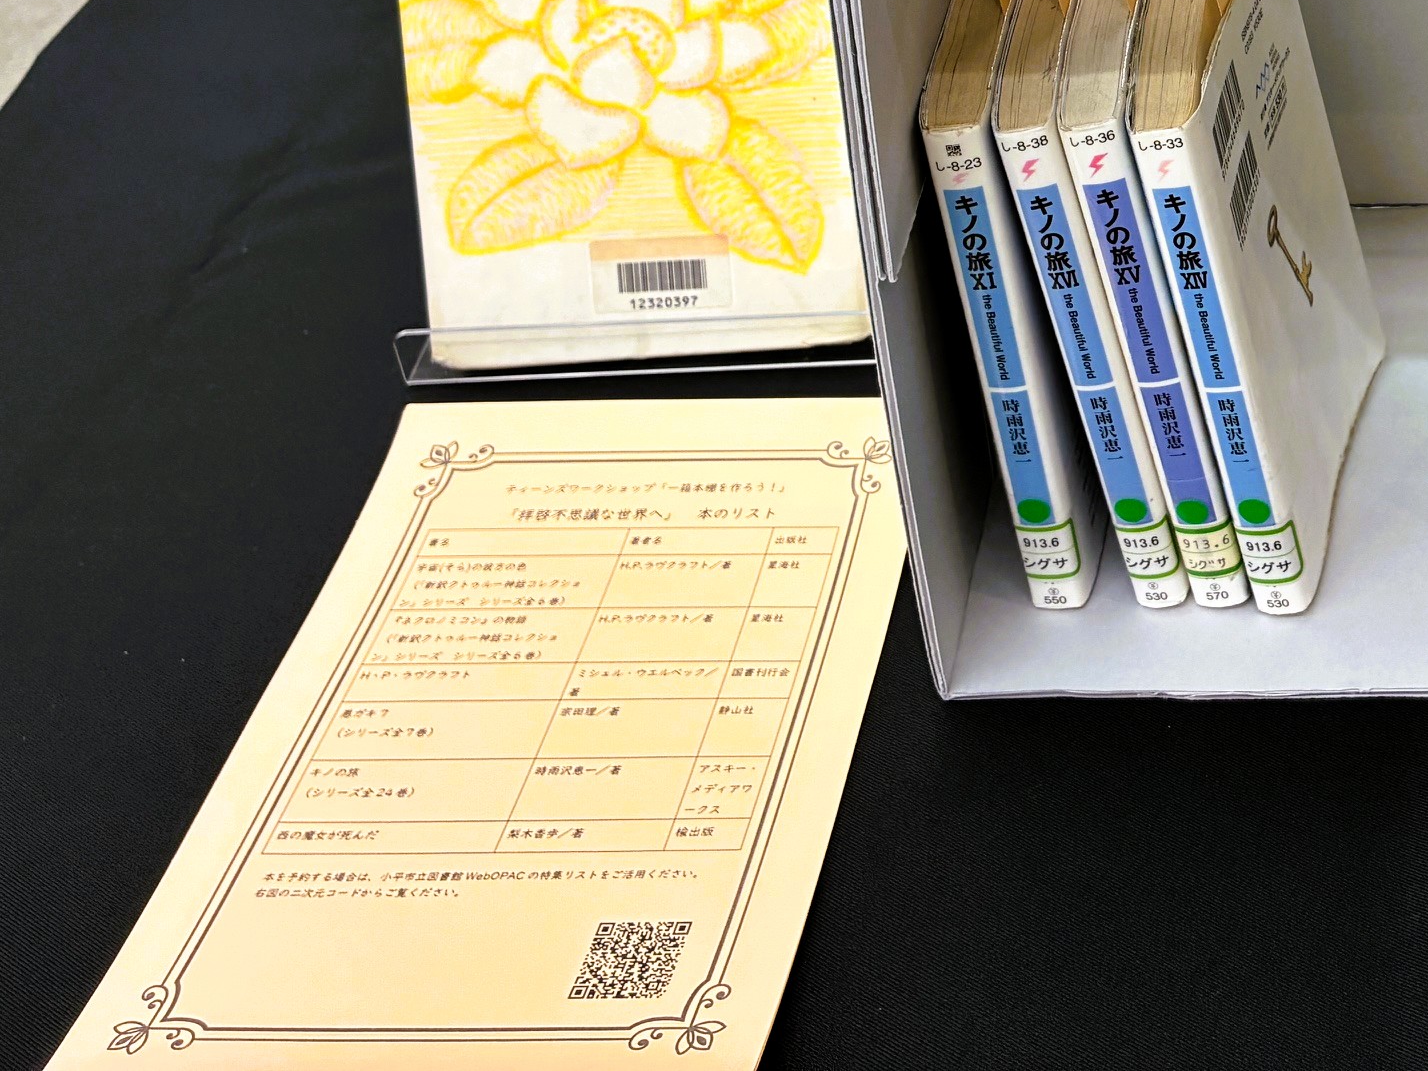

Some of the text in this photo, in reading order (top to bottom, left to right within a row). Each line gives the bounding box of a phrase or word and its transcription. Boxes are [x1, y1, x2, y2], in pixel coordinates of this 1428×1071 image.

[1001, 135, 1049, 153] し-8-38
[1069, 129, 1116, 148] し-8-36
[1138, 137, 1184, 152] し-8-33
[935, 158, 982, 172] し-8-23
[629, 295, 699, 310] 12320397
[981, 294, 1009, 380] the Beautiful World
[1063, 293, 1097, 379] the Beautiful World
[1127, 288, 1160, 375] the Beautiful World
[1194, 293, 1224, 380] the Beautiful World
[1002, 399, 1032, 463] 時雨沢恵一
[1090, 396, 1123, 460] 時雨沢恵一
[1154, 392, 1187, 459] 時雨沢恵一
[1217, 399, 1250, 464] 時雨沢恵一
[698, 507, 776, 520] 本のリスト
[1023, 536, 1059, 548] 913.6
[1124, 535, 1159, 547] 913.6
[1183, 533, 1230, 549] 913.6
[1246, 540, 1282, 552] 913.6
[1024, 556, 1068, 569] シグサ
[1125, 555, 1169, 568] シグサ
[1188, 557, 1226, 569] シグサ
[1248, 560, 1291, 573] シグサ
[1044, 595, 1067, 605] 550
[1145, 591, 1168, 601] 530
[1206, 590, 1229, 601] 570
[1266, 598, 1290, 609] 530
